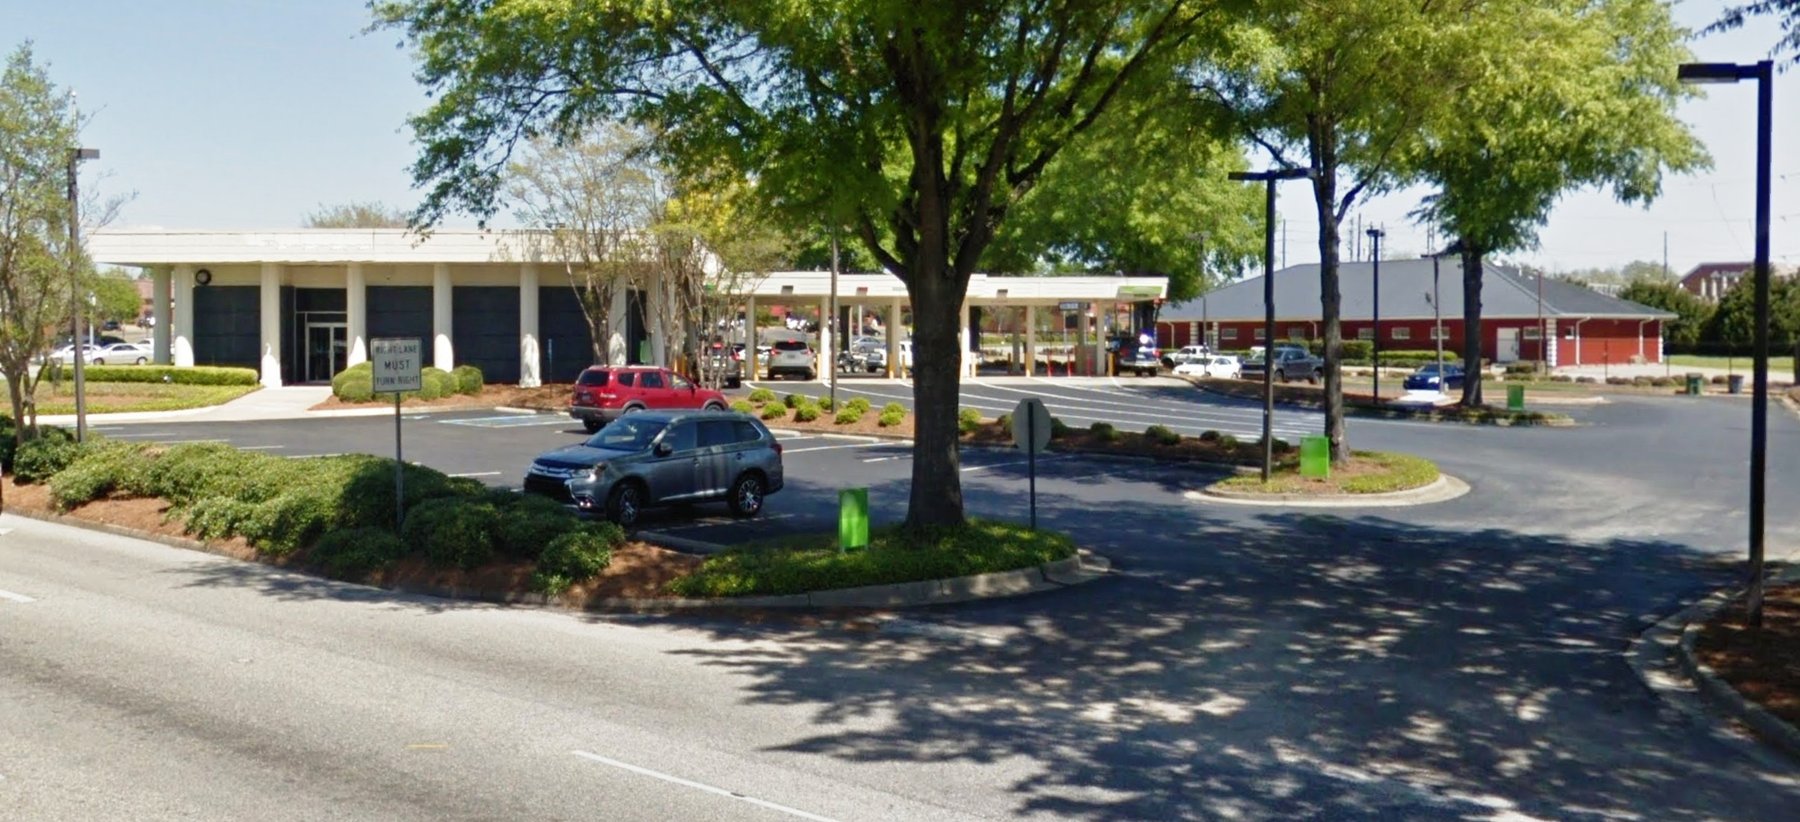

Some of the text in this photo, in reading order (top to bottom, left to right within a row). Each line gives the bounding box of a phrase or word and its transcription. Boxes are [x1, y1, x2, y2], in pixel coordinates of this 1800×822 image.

[399, 344, 417, 353] LANE
[384, 360, 410, 370] MUST
[376, 375, 418, 385] TURN RIGHT
